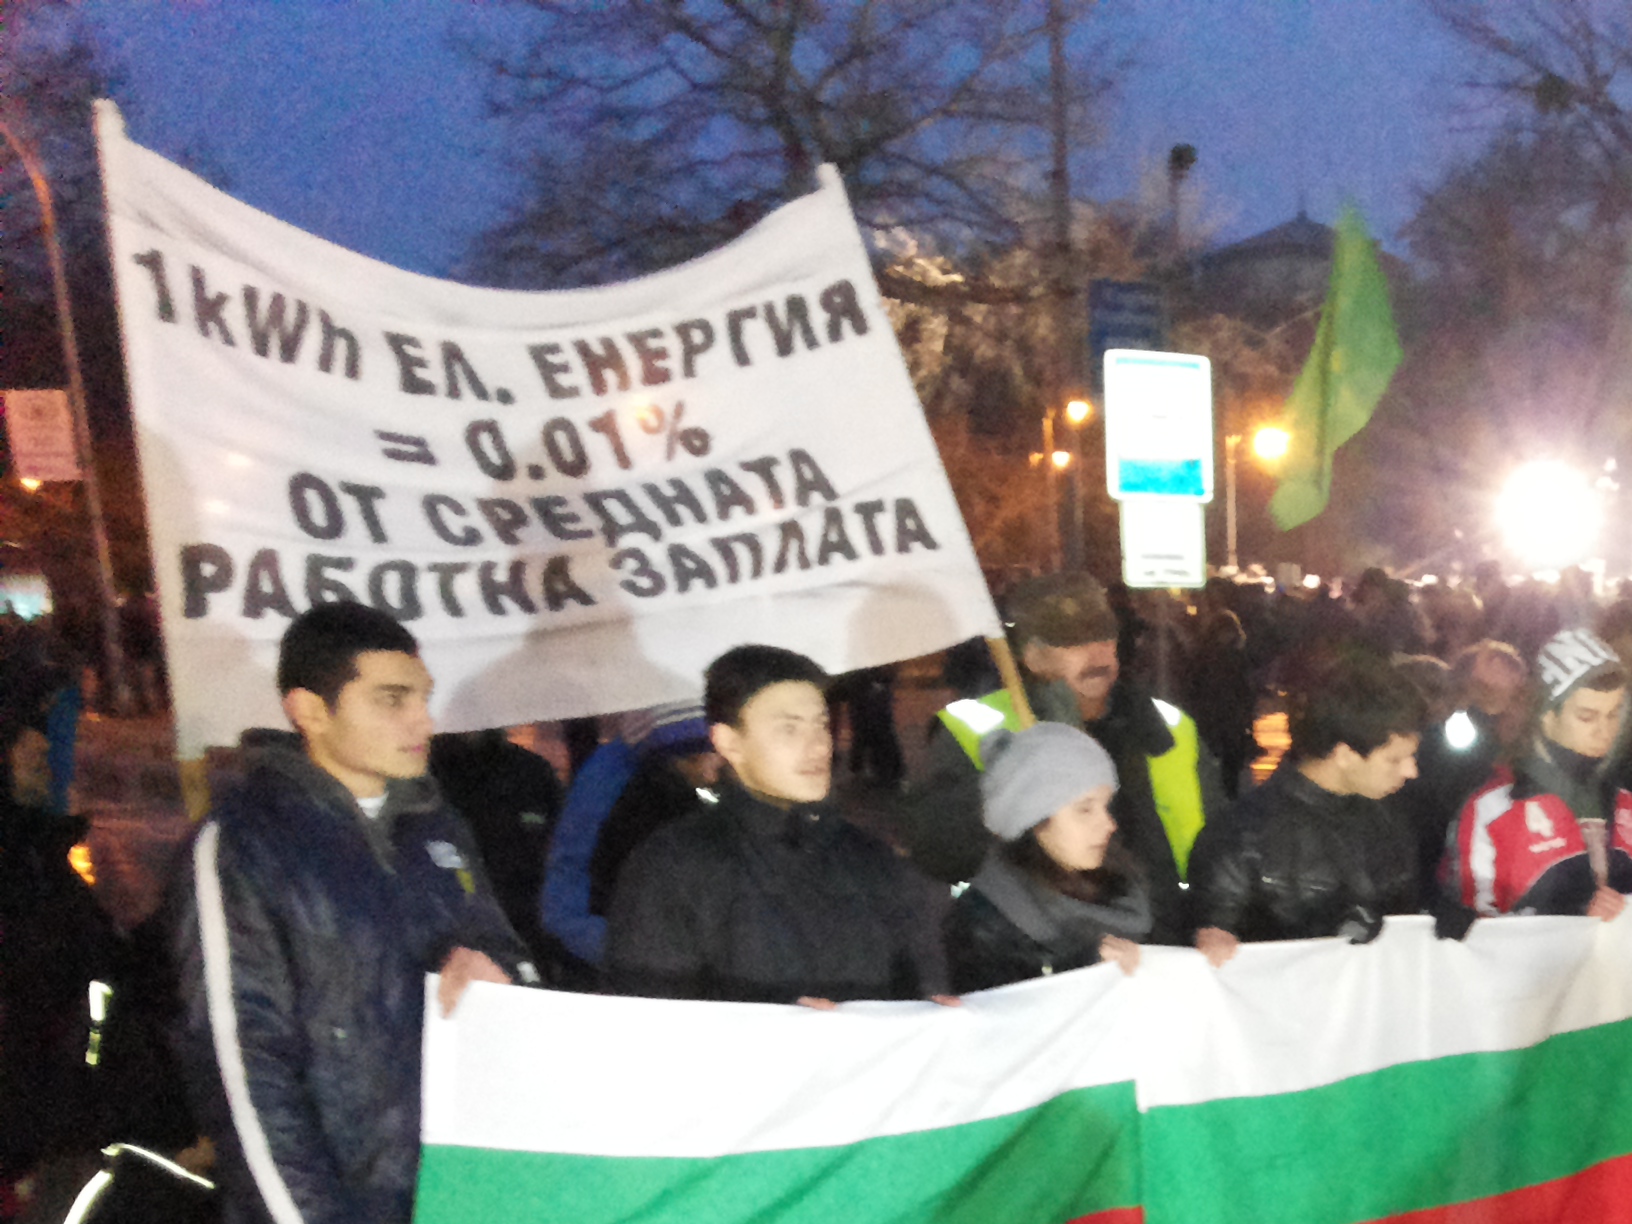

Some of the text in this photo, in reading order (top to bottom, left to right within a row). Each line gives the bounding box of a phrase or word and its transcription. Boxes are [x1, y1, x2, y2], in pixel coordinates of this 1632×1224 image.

[382, 329, 516, 405] ЕЛ.
[526, 279, 870, 399] ЕНЕРГИЯ
[464, 400, 712, 482] 0.01%
[288, 448, 840, 548] ОТ СРЕДНАТА
[177, 497, 942, 621] РАБОТНА ЗАПЛАТА
